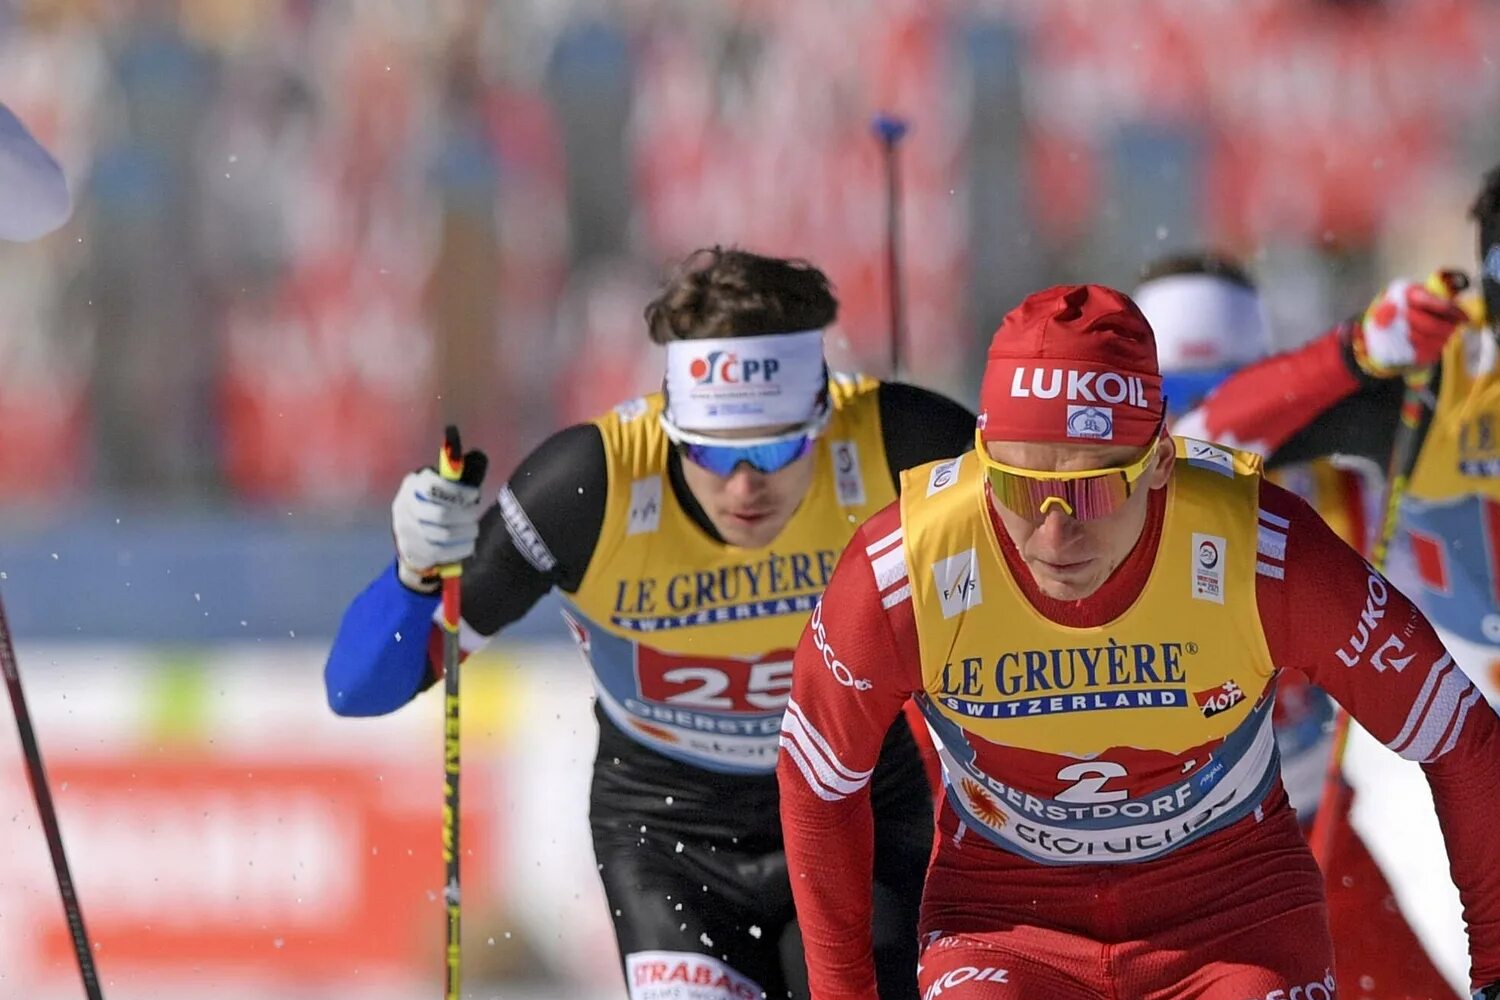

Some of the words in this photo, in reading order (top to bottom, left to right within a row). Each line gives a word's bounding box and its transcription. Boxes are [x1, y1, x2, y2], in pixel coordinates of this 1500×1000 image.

[1010, 367, 1148, 408] LUKOIL
[615, 578, 657, 613] LE
[620, 596, 813, 631] SWITZERLAN
[1335, 560, 1387, 668] LUKO
[811, 599, 854, 687] OSCO
[661, 658, 794, 712] 25
[942, 657, 983, 697] LE
[947, 691, 1178, 717] SWITZERLAND
[1202, 690, 1241, 713] AOP
[1055, 762, 1128, 803] 2
